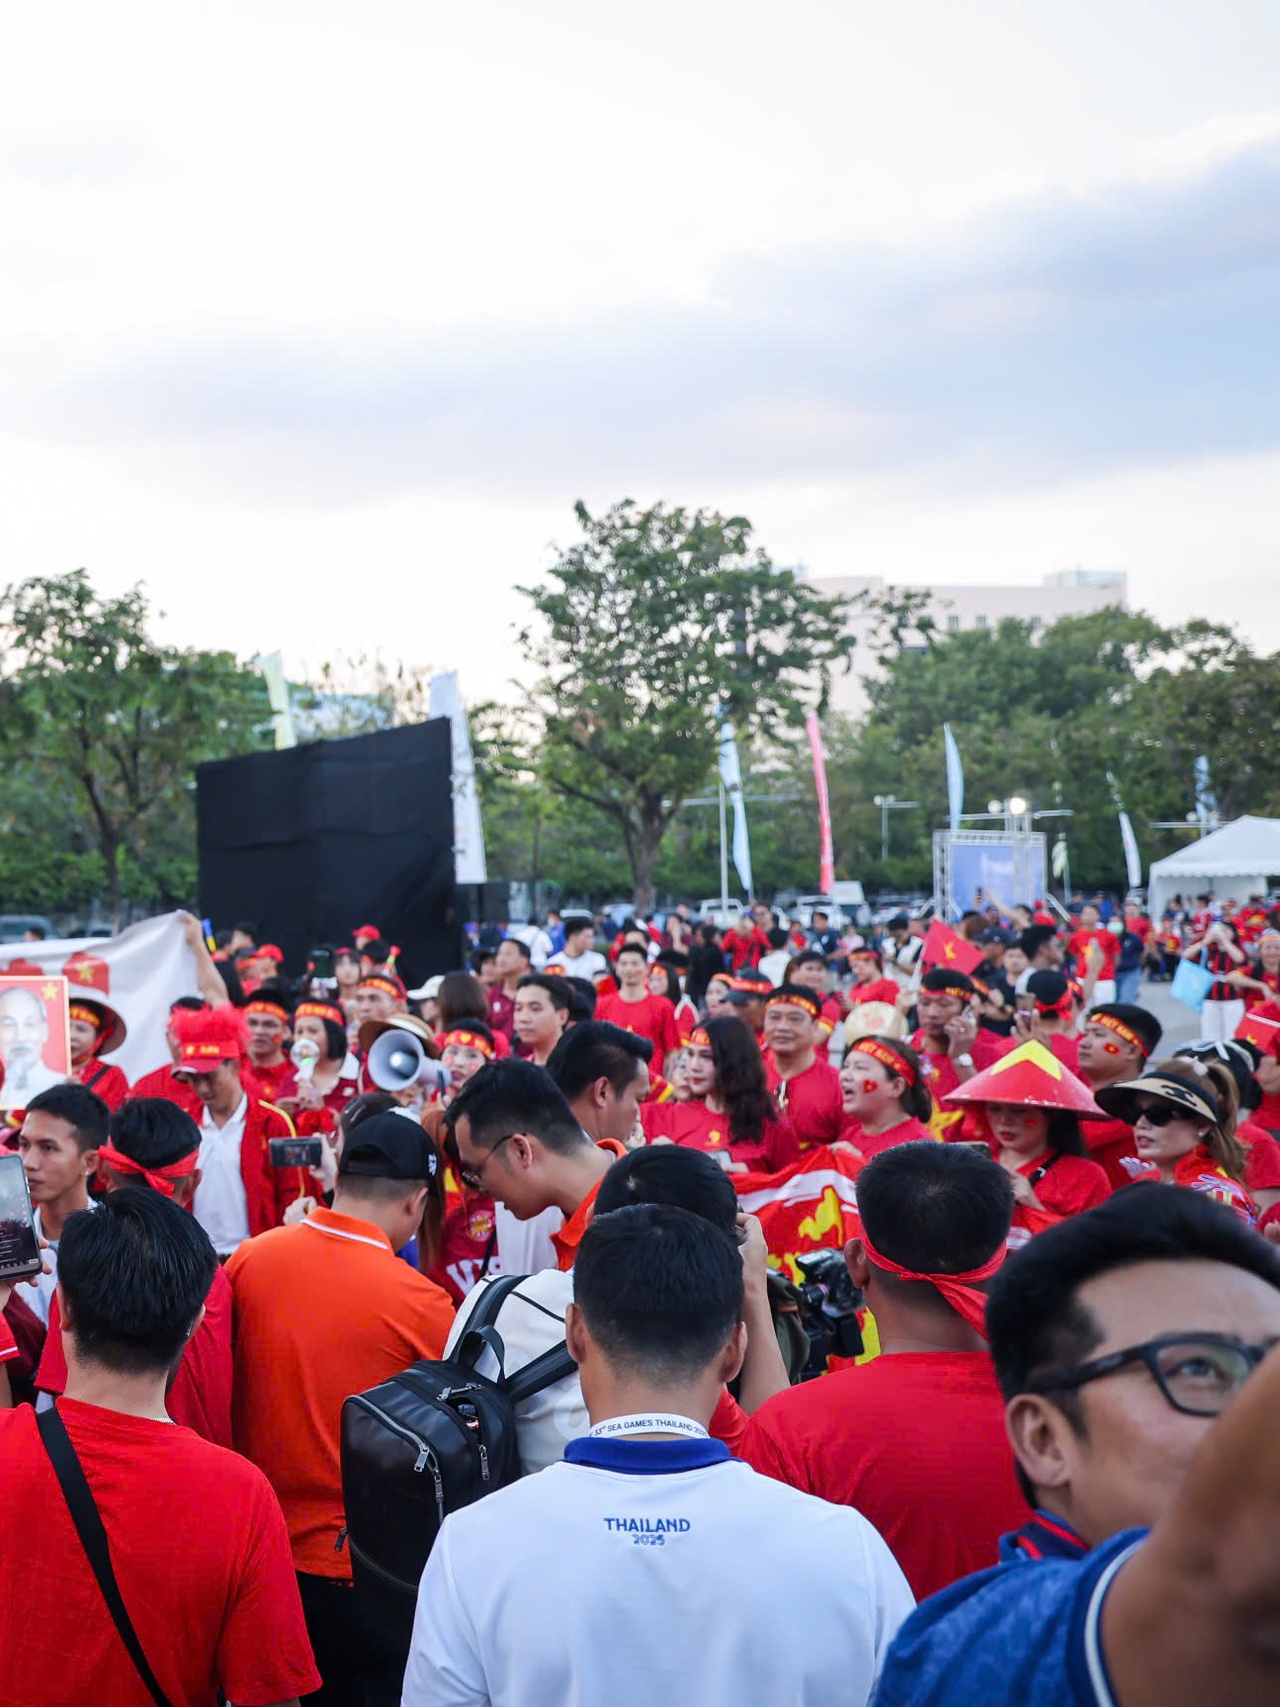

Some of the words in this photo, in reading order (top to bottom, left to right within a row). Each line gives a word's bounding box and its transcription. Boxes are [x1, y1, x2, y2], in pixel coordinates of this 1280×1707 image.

[607, 1424, 623, 1432] SEA
[624, 1419, 654, 1429] GAMES
[655, 1419, 693, 1431] THAILAND
[603, 1517, 691, 1532] THAILAND
[631, 1533, 666, 1546] 2025
